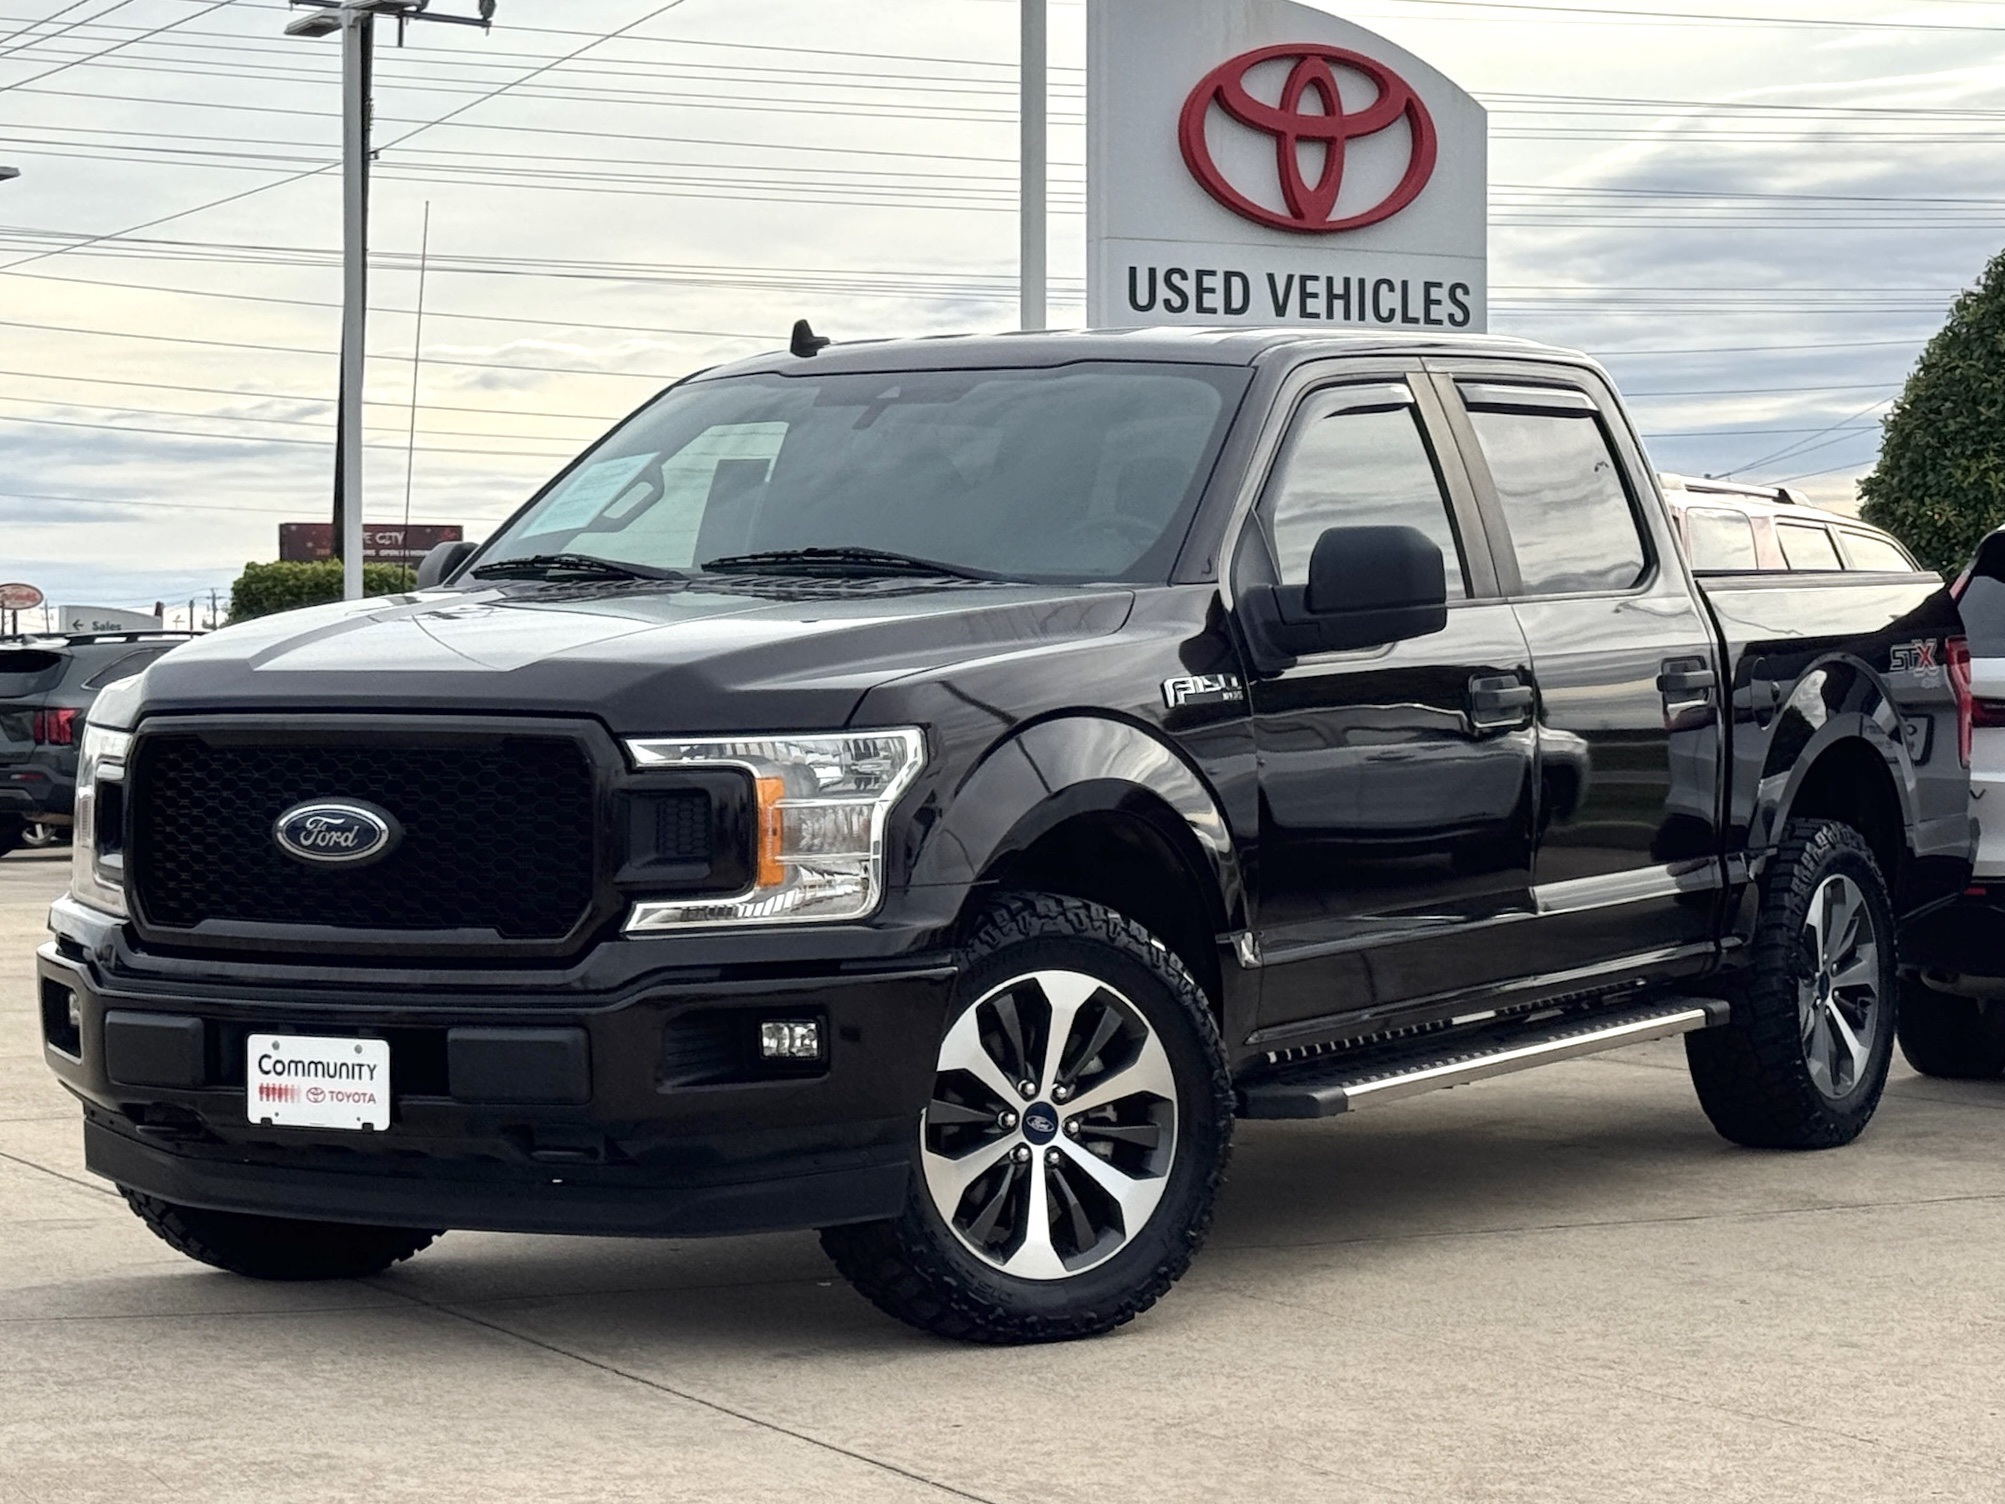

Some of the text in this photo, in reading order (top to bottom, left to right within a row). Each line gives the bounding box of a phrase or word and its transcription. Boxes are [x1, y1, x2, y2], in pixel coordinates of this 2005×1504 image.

[1128, 266, 1471, 328] USED VEHICLES
[91, 620, 122, 631] Sales
[1890, 638, 1938, 677] STX
[300, 816, 360, 848] Ford
[328, 1090, 377, 1104] TOYOTA
